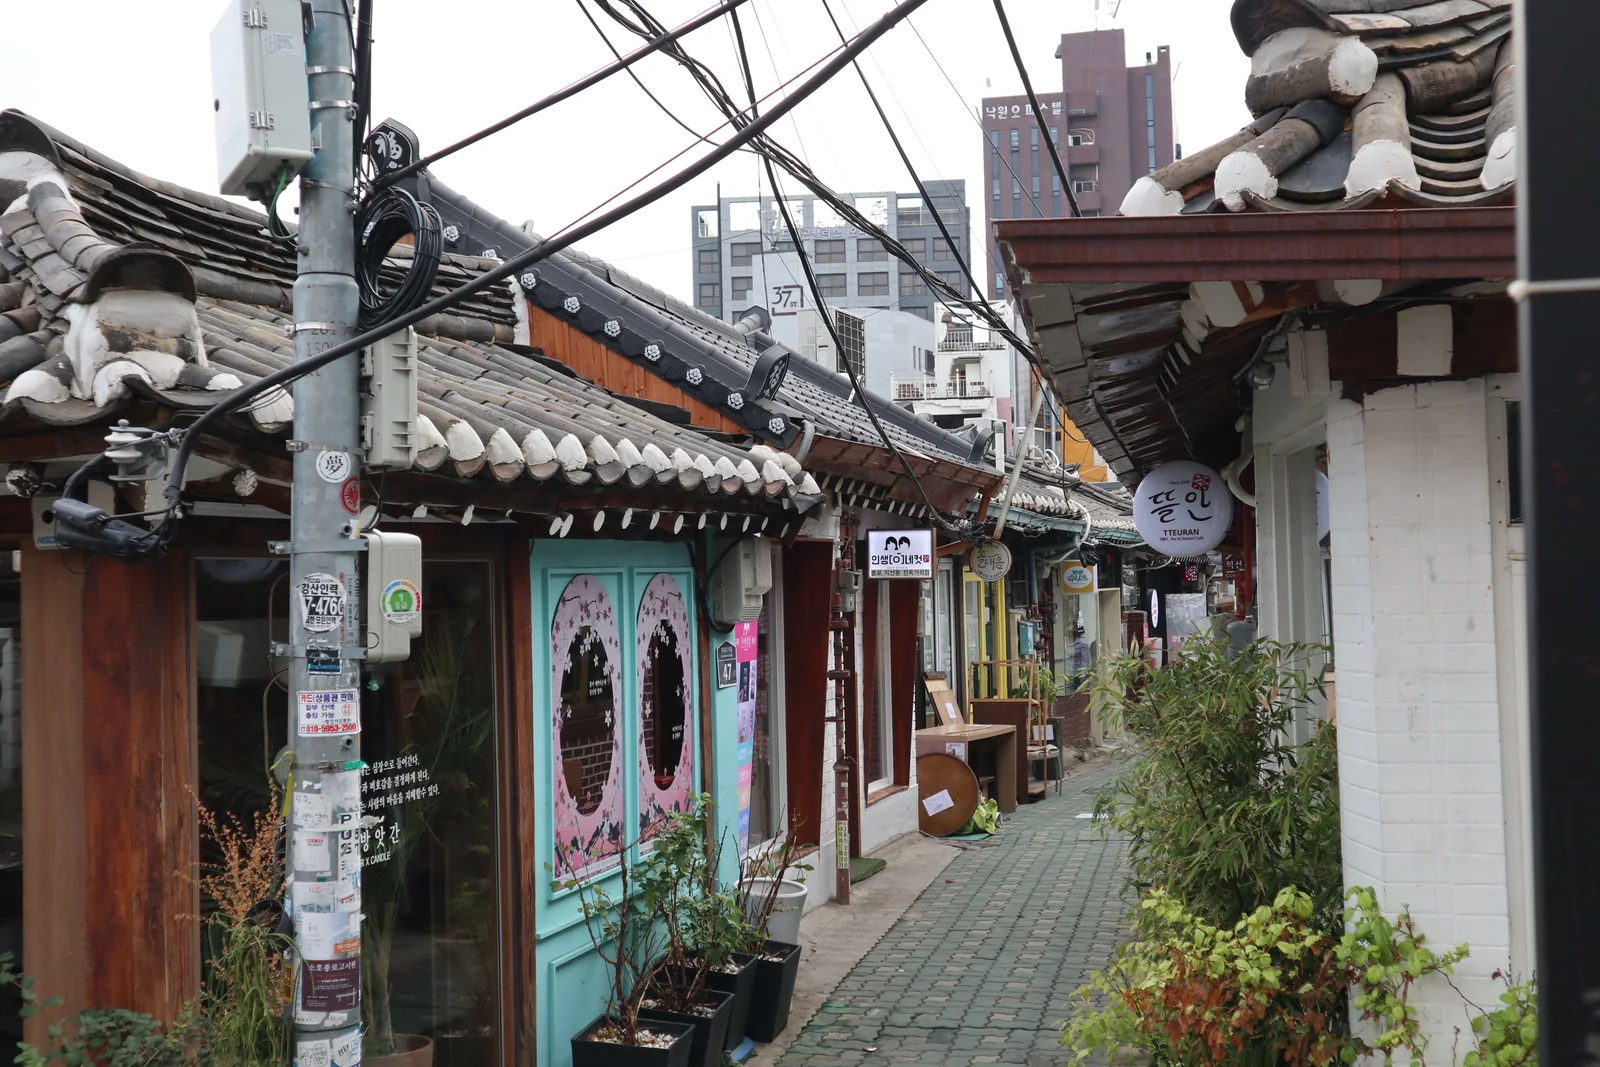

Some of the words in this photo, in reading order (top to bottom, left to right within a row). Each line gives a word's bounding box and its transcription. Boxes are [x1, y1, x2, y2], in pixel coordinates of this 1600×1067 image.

[772, 286, 792, 308] 37
[301, 583, 338, 595] 강산인력
[398, 593, 403, 601] 1
[723, 663, 732, 681] 47
[372, 760, 395, 774] 심장으로
[368, 795, 386, 811] 사람의
[387, 791, 404, 807] 마음을
[428, 783, 440, 796] 있다.
[370, 851, 391, 865] CANDLE
